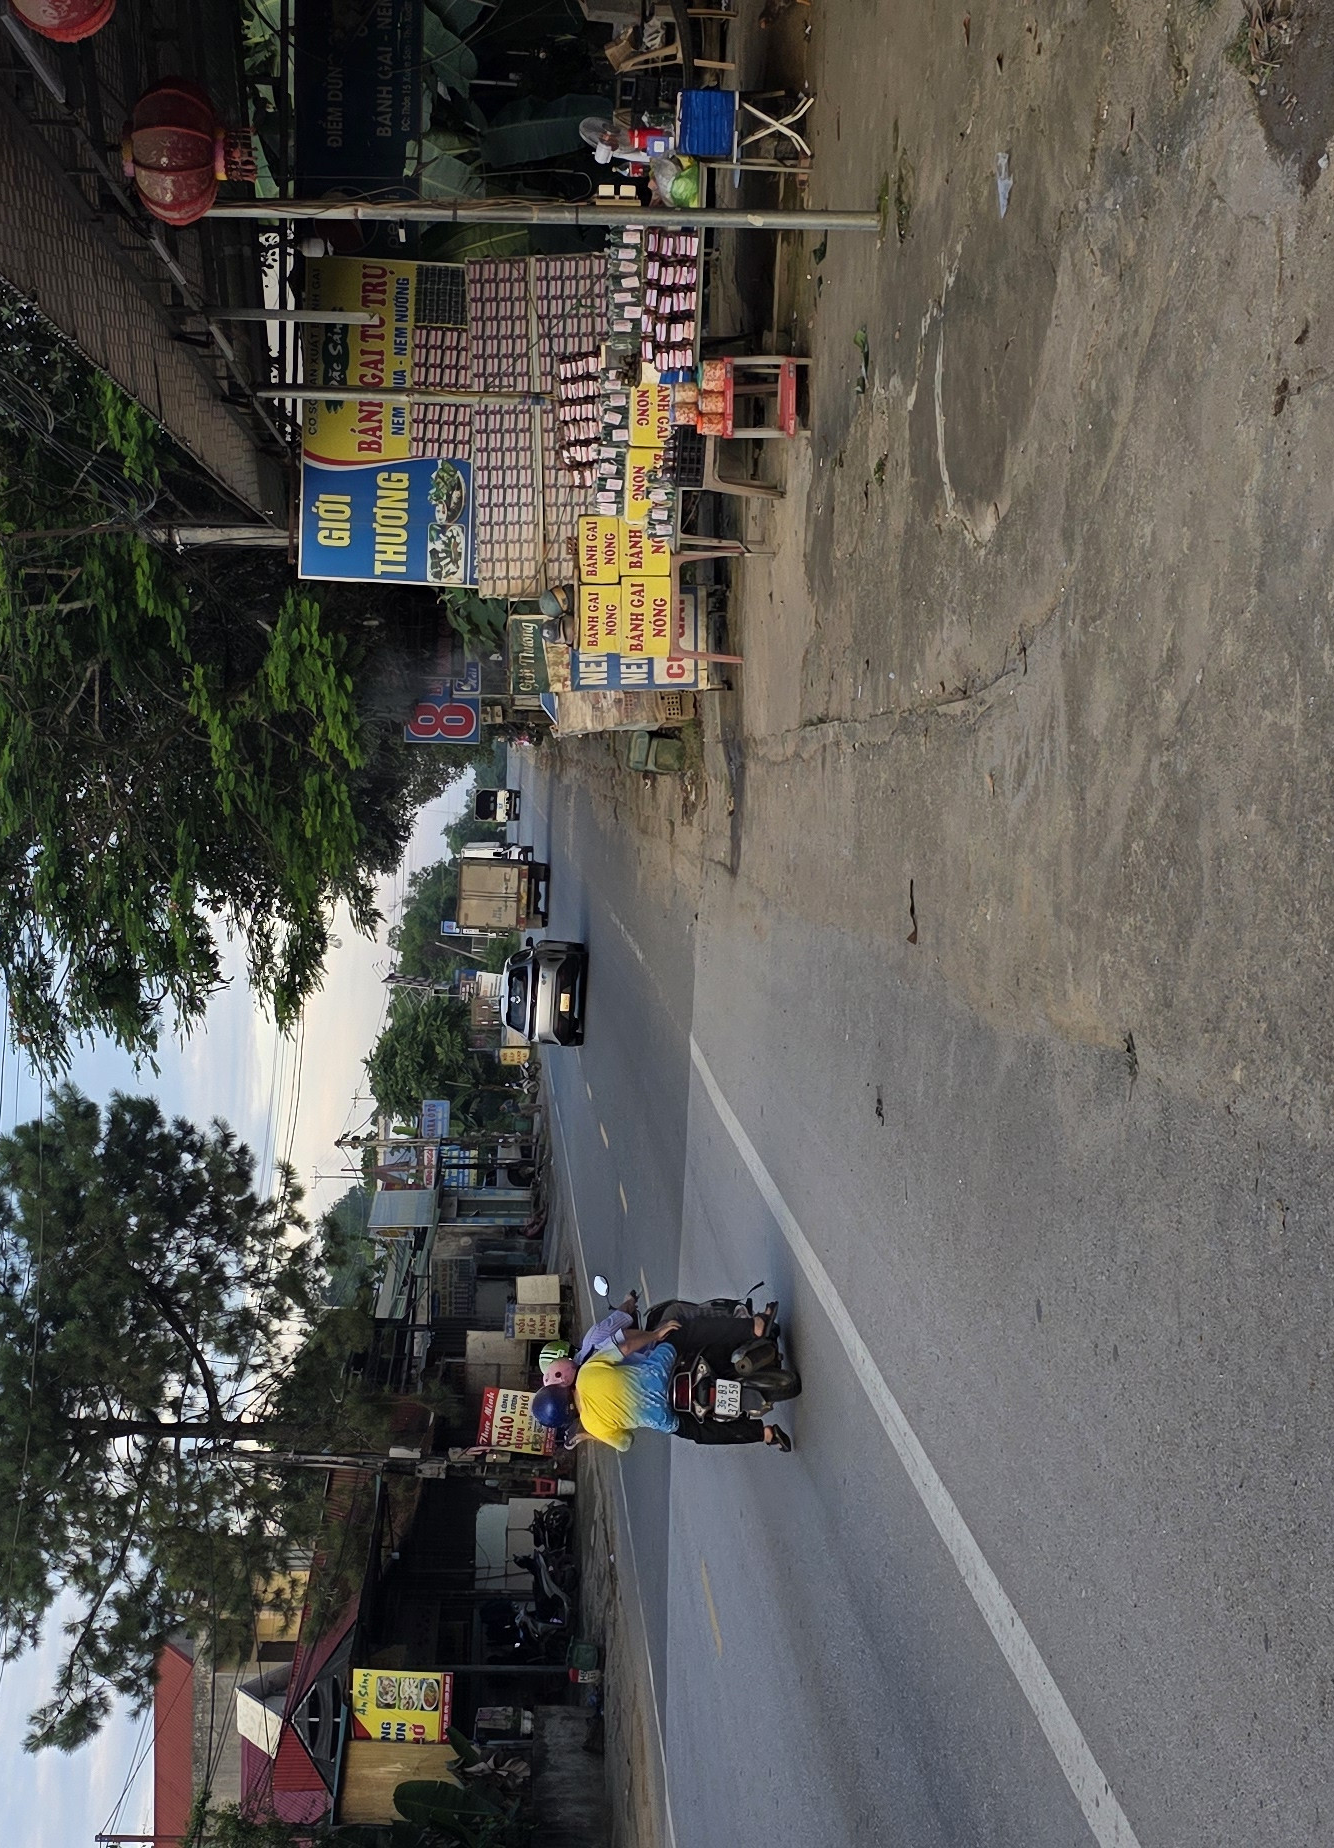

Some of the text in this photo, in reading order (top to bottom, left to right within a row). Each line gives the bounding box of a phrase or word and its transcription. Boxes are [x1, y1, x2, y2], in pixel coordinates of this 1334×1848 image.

[317, 107, 343, 147] ĐIỂM
[372, 86, 393, 137] BÁNH
[361, 264, 395, 309] TRỤ
[392, 277, 409, 323] NƯỚNG
[393, 327, 408, 356] NEM
[359, 348, 385, 387] GAI
[391, 407, 406, 436] NEM
[636, 390, 653, 426] NÓNG
[312, 493, 352, 547] GIỚI
[372, 472, 410, 575] THƯƠNG
[582, 521, 598, 577] BÁNH GAI
[601, 533, 616, 566] NÓNG
[624, 528, 643, 570] BÁNH
[583, 592, 599, 647] BÁNH GAI
[602, 604, 617, 636] NÓNG
[625, 582, 645, 652] BÁNH GAI
[648, 597, 667, 638] NÓNG
[407, 703, 476, 738] 8
[495, 1416, 515, 1447] CHÁO
